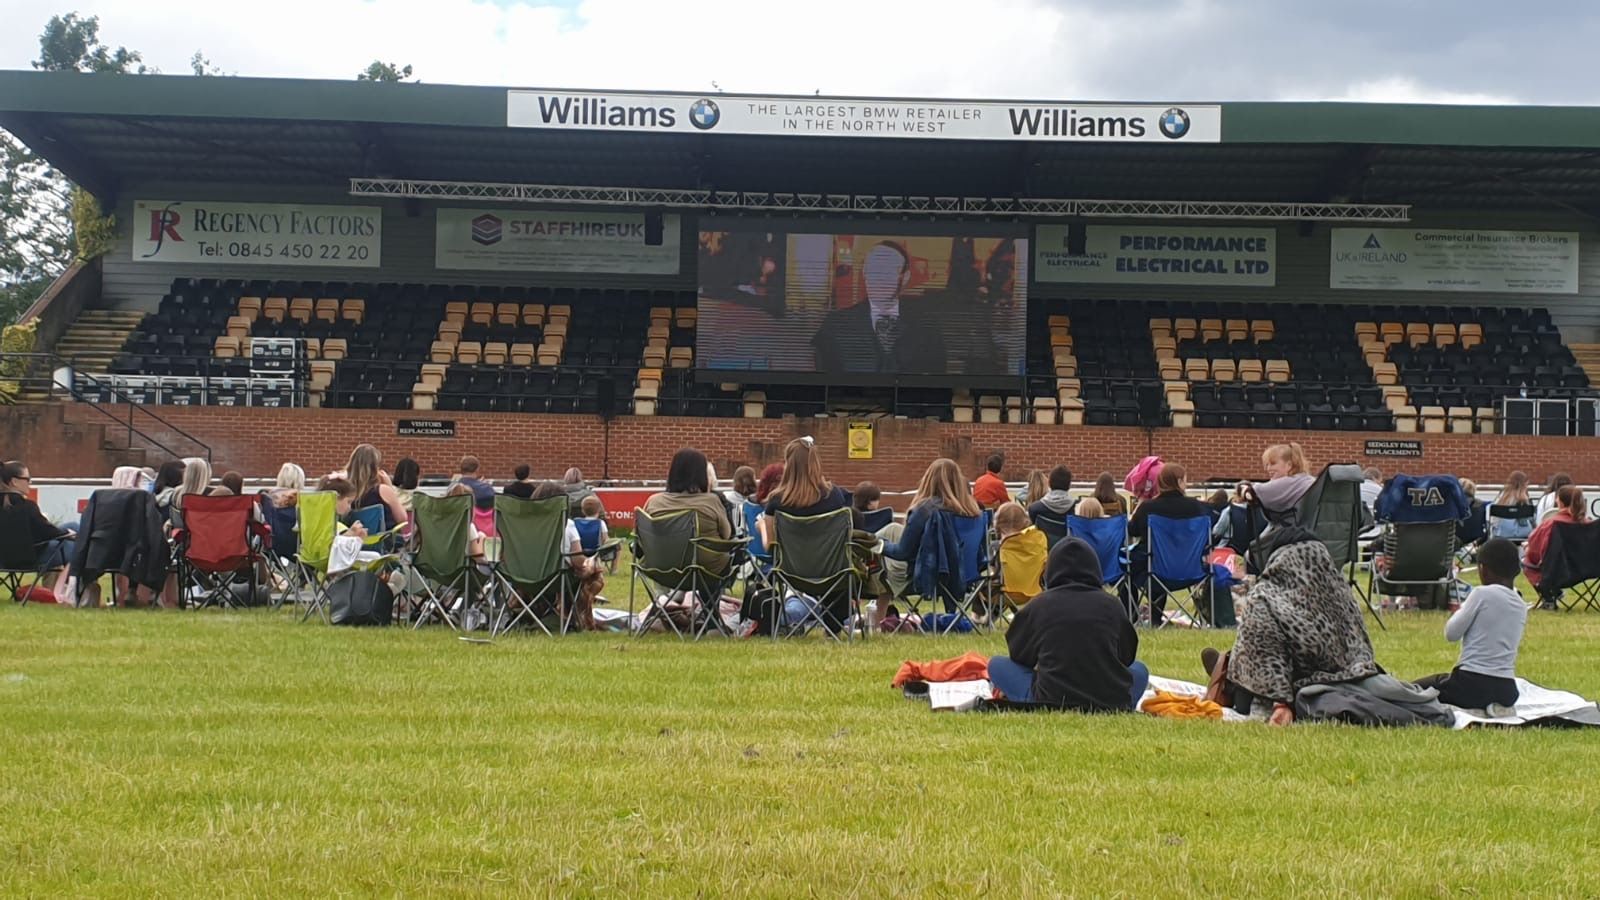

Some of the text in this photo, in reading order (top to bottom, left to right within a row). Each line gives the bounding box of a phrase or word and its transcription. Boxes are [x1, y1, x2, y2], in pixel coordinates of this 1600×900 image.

[537, 96, 676, 127] Williams
[747, 104, 982, 120] THE LARGEST BMW RETAILER
[783, 119, 946, 132] IN THE NORTH WEST
[1008, 108, 1146, 137] Williams
[509, 220, 644, 238] STAFFHIREUK
[197, 241, 369, 260] Tel: 0845 450 22 20
[1120, 235, 1267, 252] PERFORMANCE
[1116, 257, 1270, 274] ELECTRICAL LTD
[1407, 487, 1445, 506] TA
